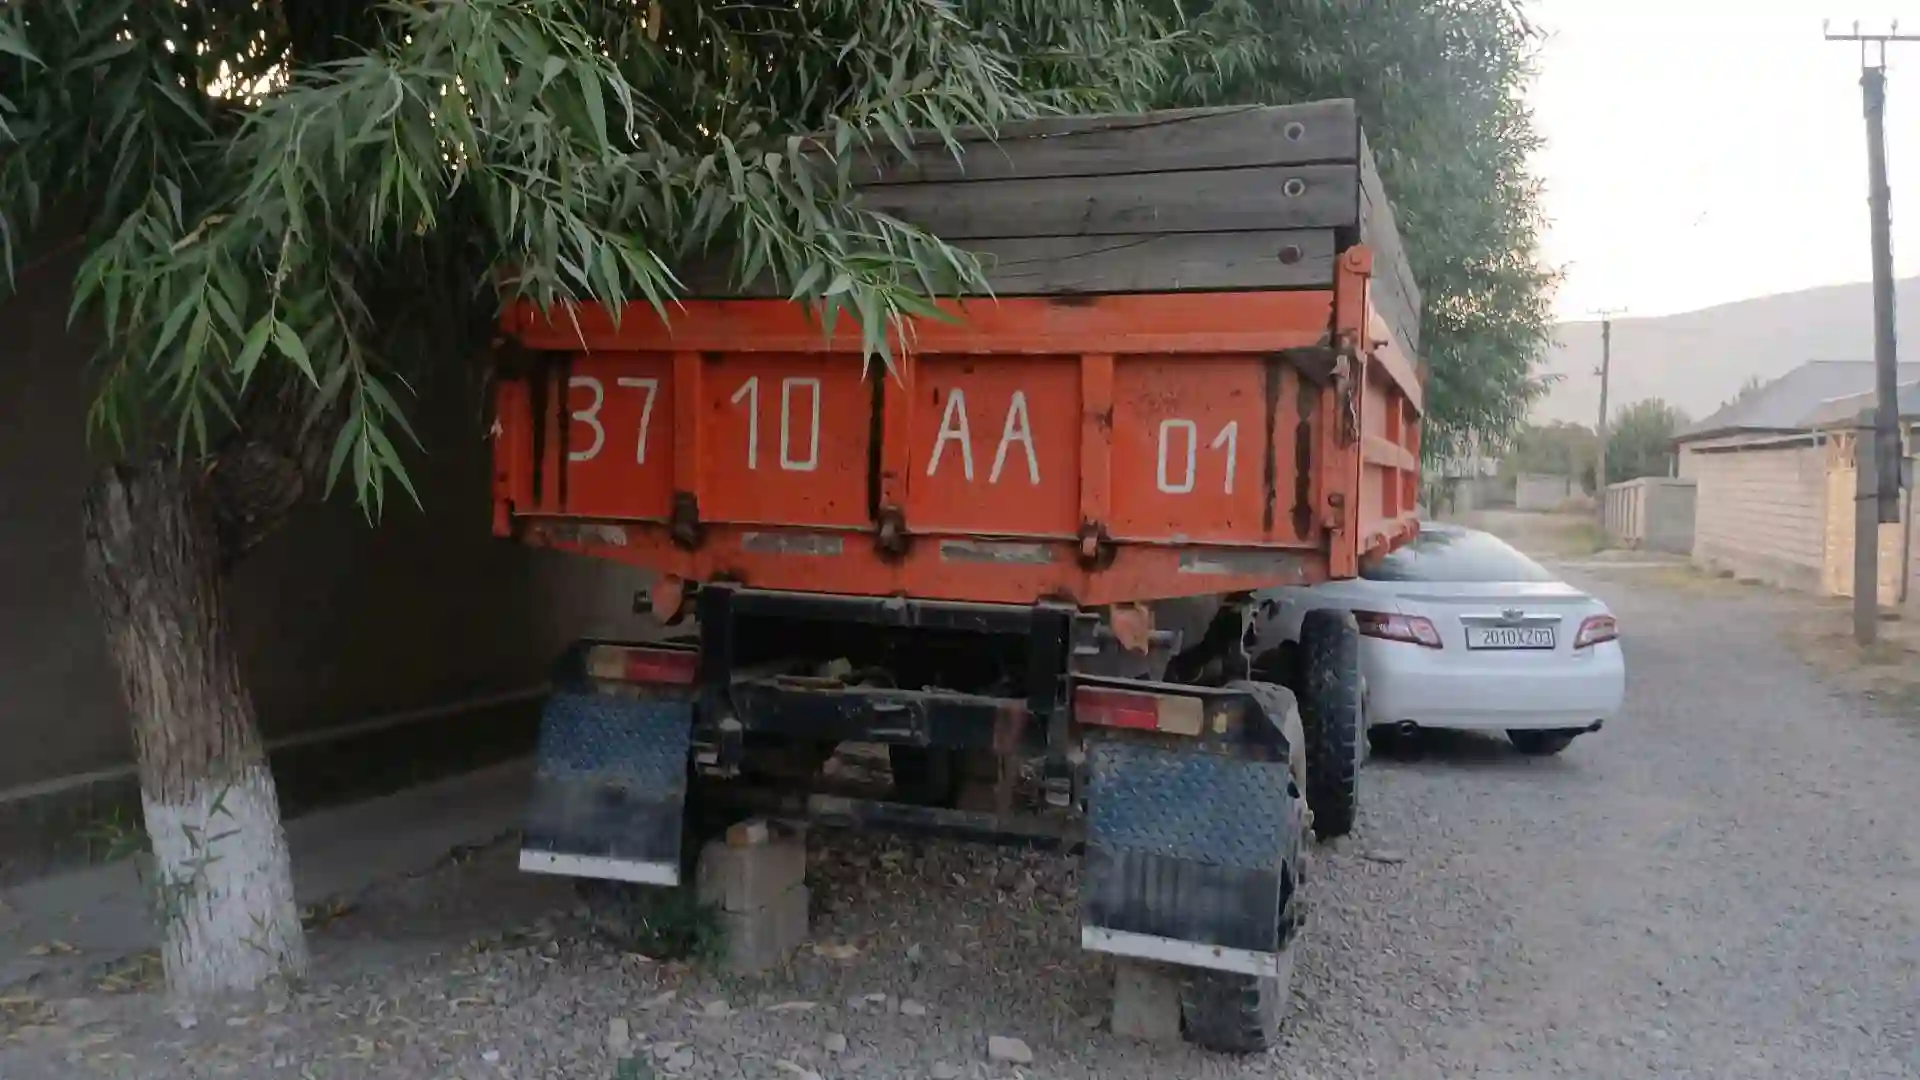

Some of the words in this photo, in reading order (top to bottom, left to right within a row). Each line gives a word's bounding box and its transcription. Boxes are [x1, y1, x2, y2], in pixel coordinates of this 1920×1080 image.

[567, 376, 659, 465] 37
[731, 376, 820, 471] 10
[926, 387, 1040, 486] AA
[1156, 419, 1238, 495] 01
